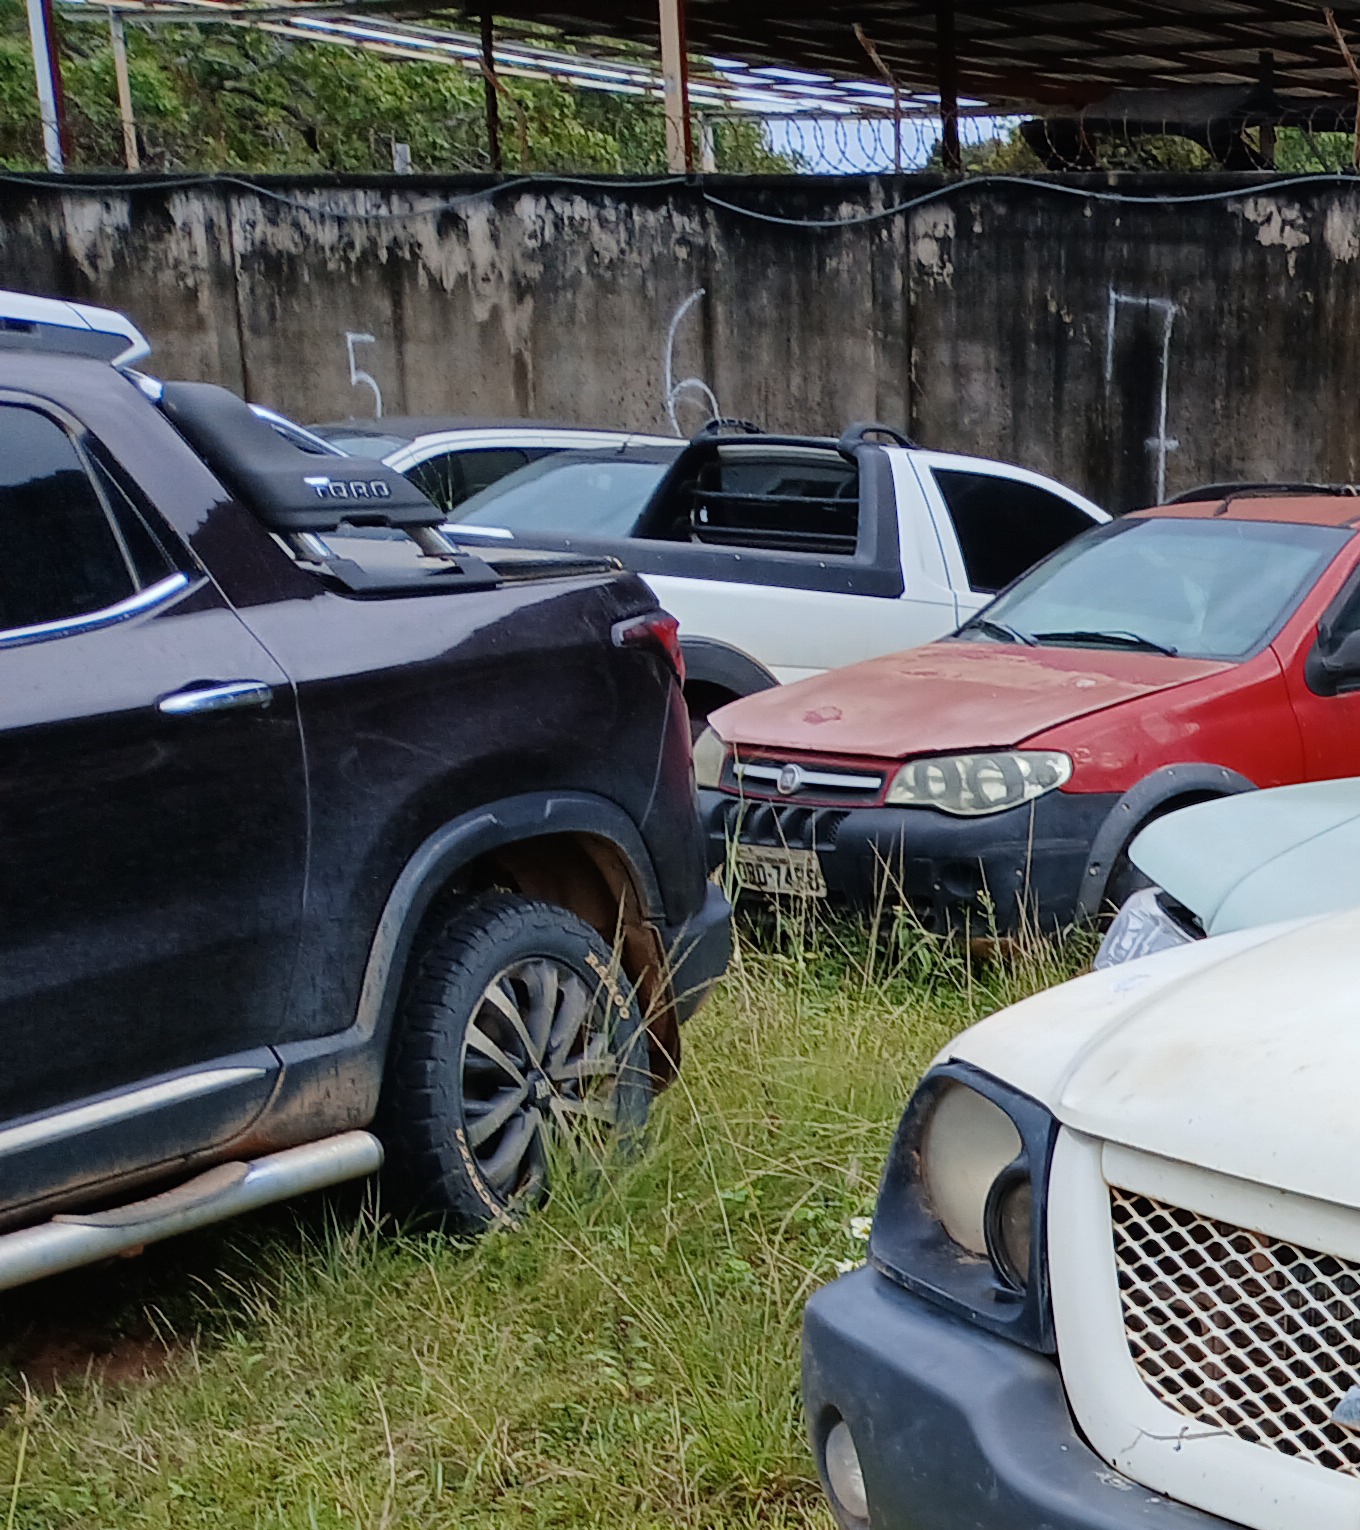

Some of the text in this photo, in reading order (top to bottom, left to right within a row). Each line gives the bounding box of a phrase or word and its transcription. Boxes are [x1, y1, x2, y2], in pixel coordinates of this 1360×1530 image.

[345, 331, 382, 418] 5
[665, 287, 722, 438] 6
[303, 476, 391, 499] TORO
